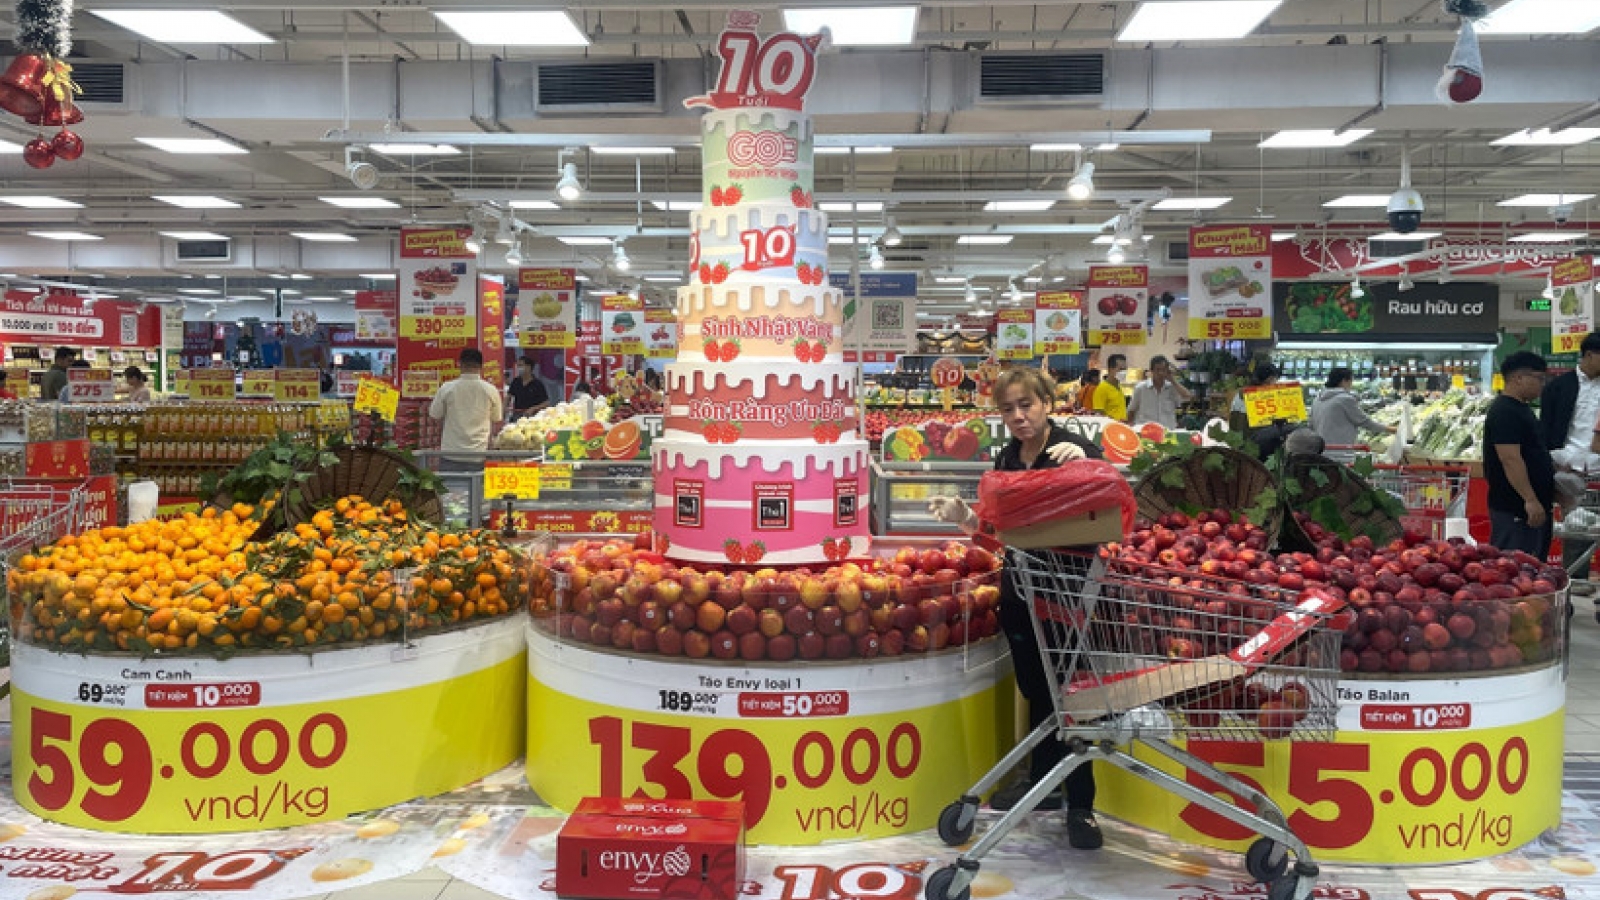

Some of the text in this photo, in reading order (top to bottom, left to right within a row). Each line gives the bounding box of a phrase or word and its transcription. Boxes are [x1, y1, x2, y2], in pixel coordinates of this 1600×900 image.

[721, 35, 811, 97] 10
[742, 227, 794, 264] 10
[1388, 300, 1483, 314] Rau hữu cơ
[415, 318, 465, 334] 390.000
[702, 316, 741, 338] Sinh
[748, 315, 793, 344] Nhật
[253, 382, 269, 392] 47
[936, 369, 960, 384] 10
[72, 384, 102, 396] 275
[198, 384, 224, 396] 114
[284, 385, 309, 397] 114
[488, 474, 519, 489] 139
[121, 669, 192, 681] Cam Canh
[699, 676, 801, 690] Táo Envy loại 1
[193, 684, 252, 706] 10.000
[781, 693, 842, 716] 50.000
[1336, 687, 1410, 701] Táo Balan
[1365, 705, 1465, 727] TIẾT KIỆM 10.000
[28, 706, 348, 822] 59.000
[588, 715, 922, 831] 139.000
[184, 780, 329, 823] vnd/kg
[1179, 736, 1529, 849] 55.000
[796, 791, 908, 833] vnd/kg
[1398, 807, 1513, 851] vnd/kg
[116, 851, 278, 885] 10
[599, 850, 664, 884] envy
[778, 864, 909, 900] 10
